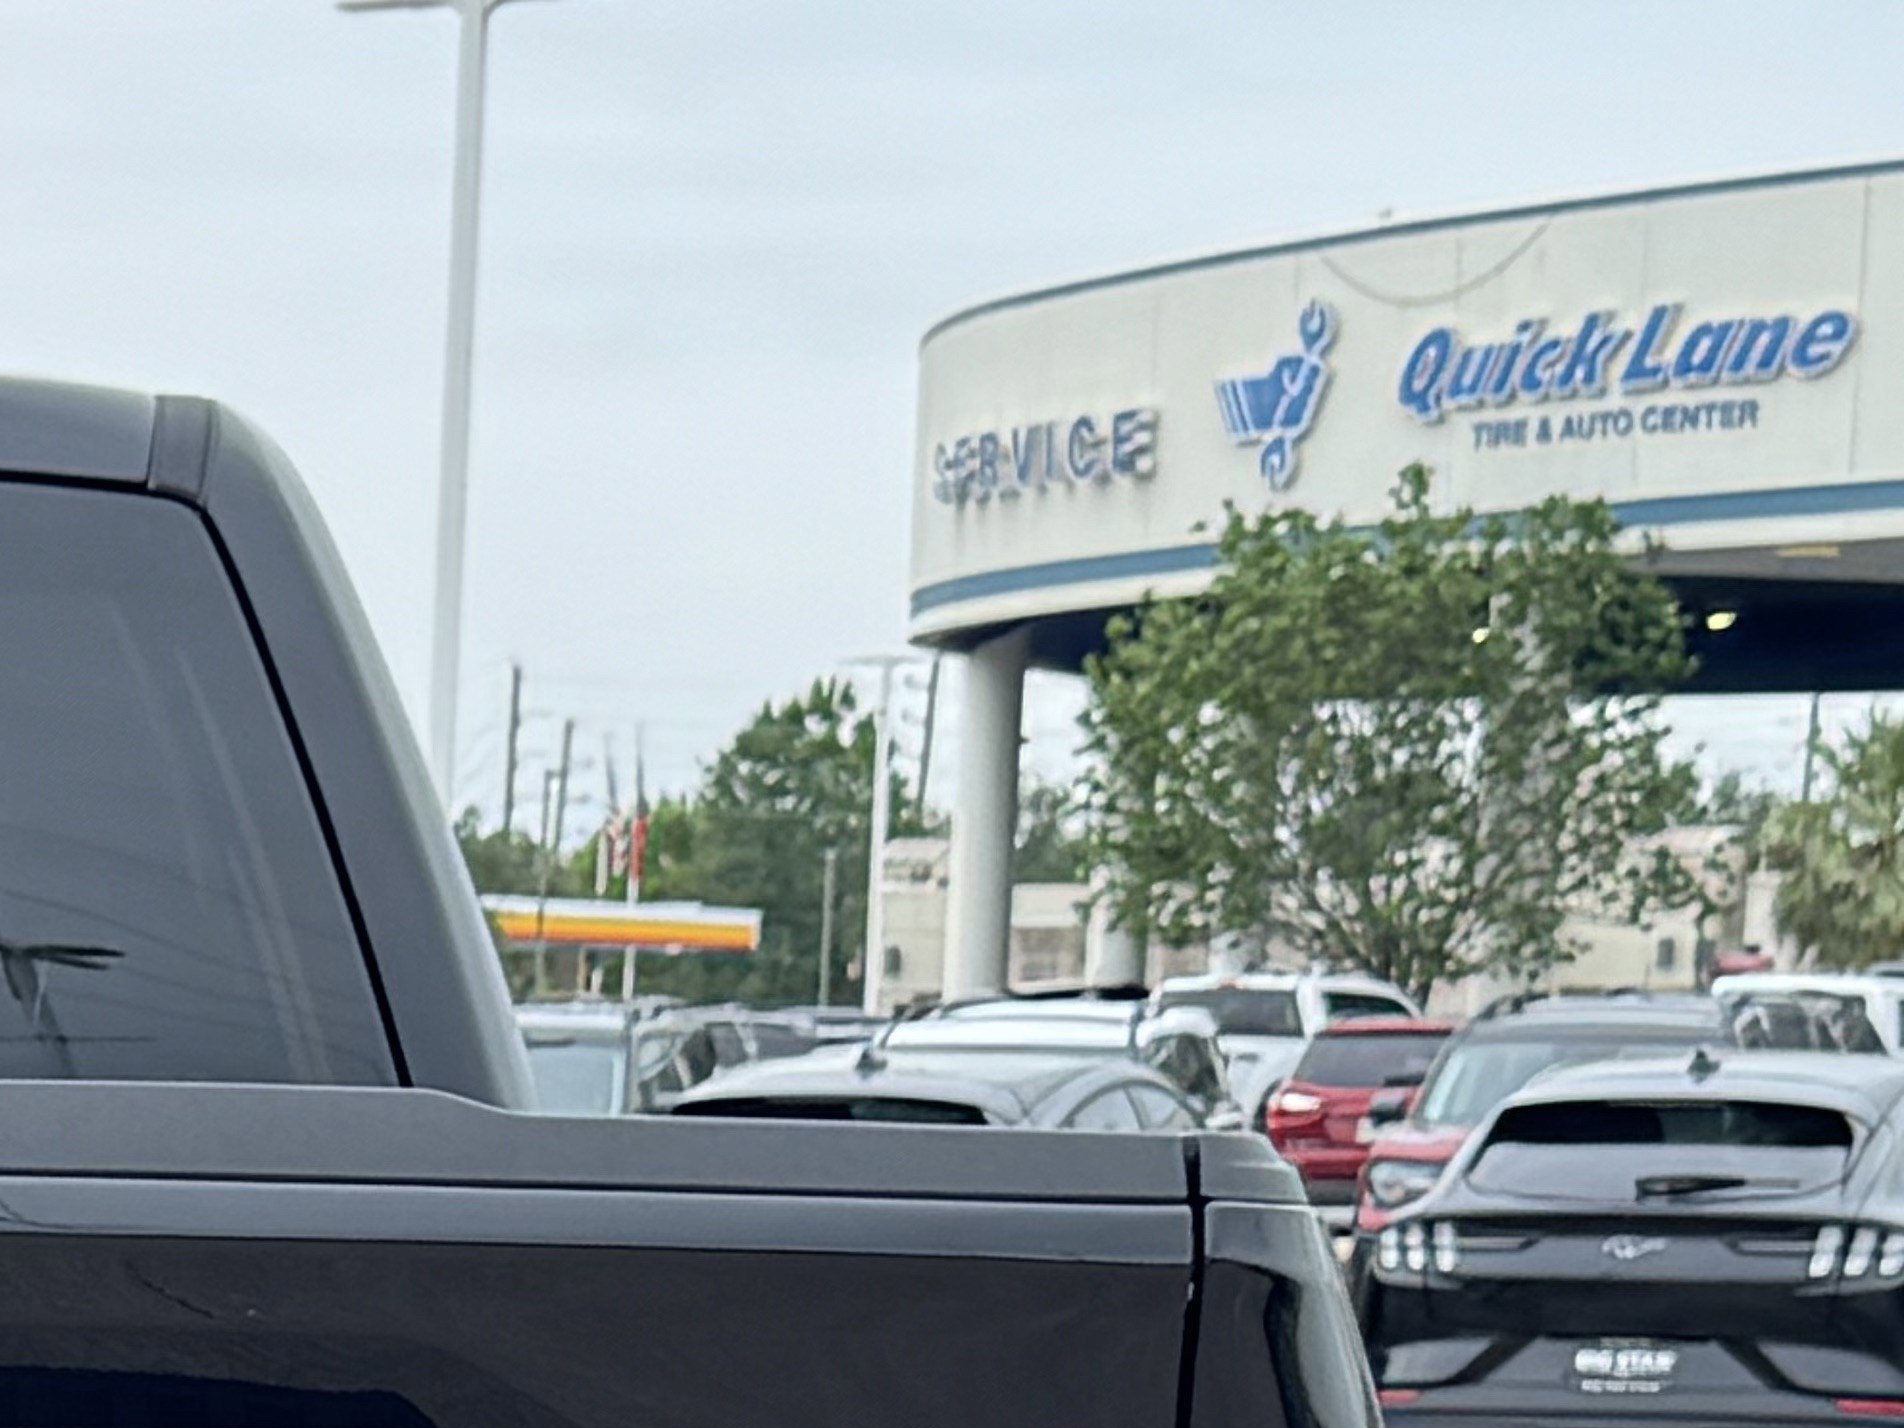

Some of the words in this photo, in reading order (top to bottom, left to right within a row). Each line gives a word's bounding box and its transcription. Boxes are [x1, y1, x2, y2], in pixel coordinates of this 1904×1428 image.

[1398, 309, 1630, 421] Quick
[1618, 304, 1856, 388] Lane
[934, 410, 1160, 505] SERVICE
[1473, 417, 1529, 450] TIRE
[1535, 416, 1554, 444] &
[1559, 408, 1634, 441] AUTO
[1642, 399, 1761, 433] CENTER
